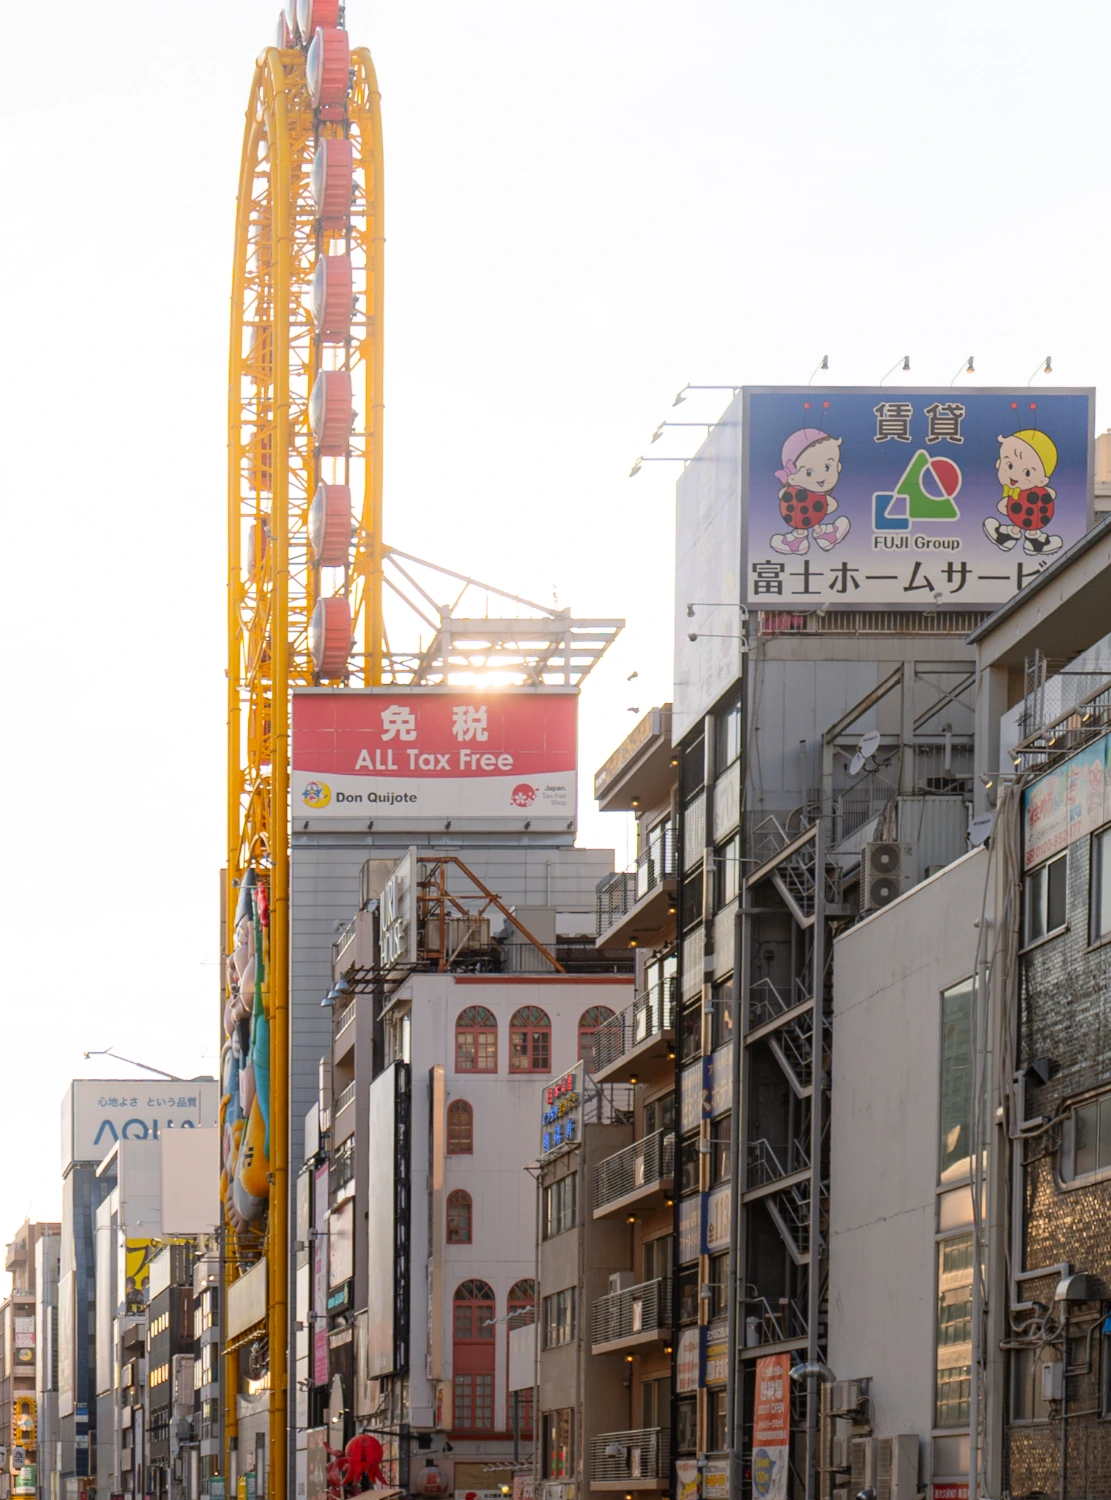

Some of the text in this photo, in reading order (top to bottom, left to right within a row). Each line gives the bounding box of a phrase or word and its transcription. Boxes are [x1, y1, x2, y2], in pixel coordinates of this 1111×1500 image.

[874, 403, 965, 443] 賃貸
[874, 536, 960, 551] FUJI Group
[381, 704, 489, 742] 免税
[355, 749, 514, 770] ALL Tax Free
[336, 791, 418, 806] Don Quijote
[98, 1096, 197, 1107] 心地よさ という品質
